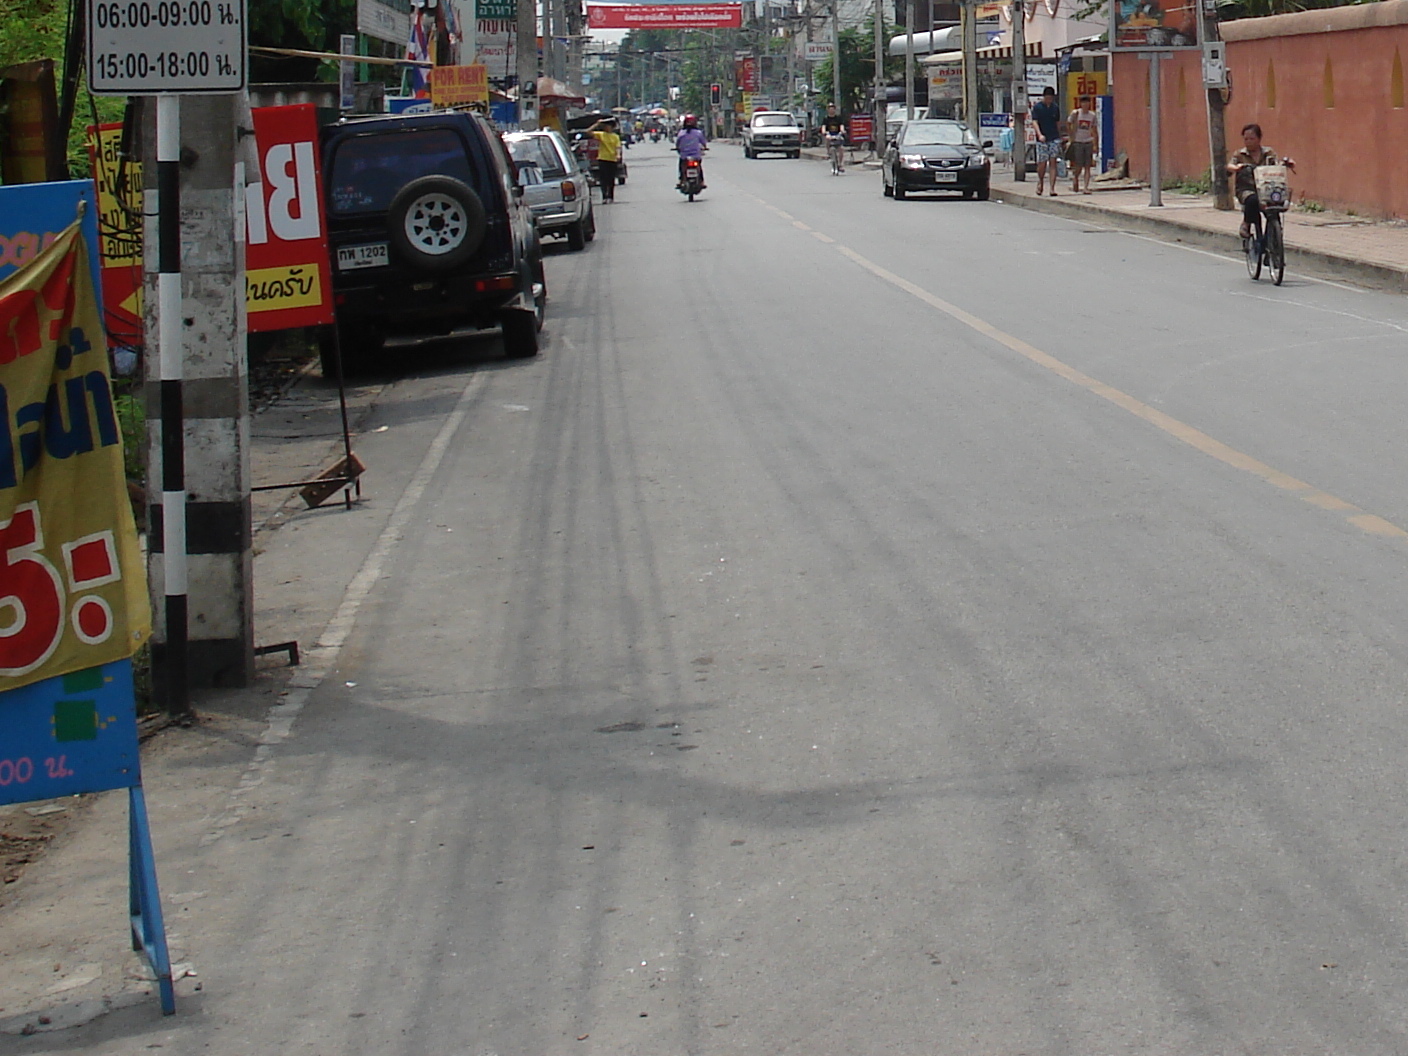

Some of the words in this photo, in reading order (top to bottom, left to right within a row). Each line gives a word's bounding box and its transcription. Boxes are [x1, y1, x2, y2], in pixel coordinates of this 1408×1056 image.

[97, 1, 211, 28] 06:00-09:00
[218, 3, 239, 25] น.
[97, 52, 209, 79] 15:00-18:00
[216, 54, 237, 76] น.
[360, 246, 386, 258] 1202
[245, 269, 314, 302] นครับ
